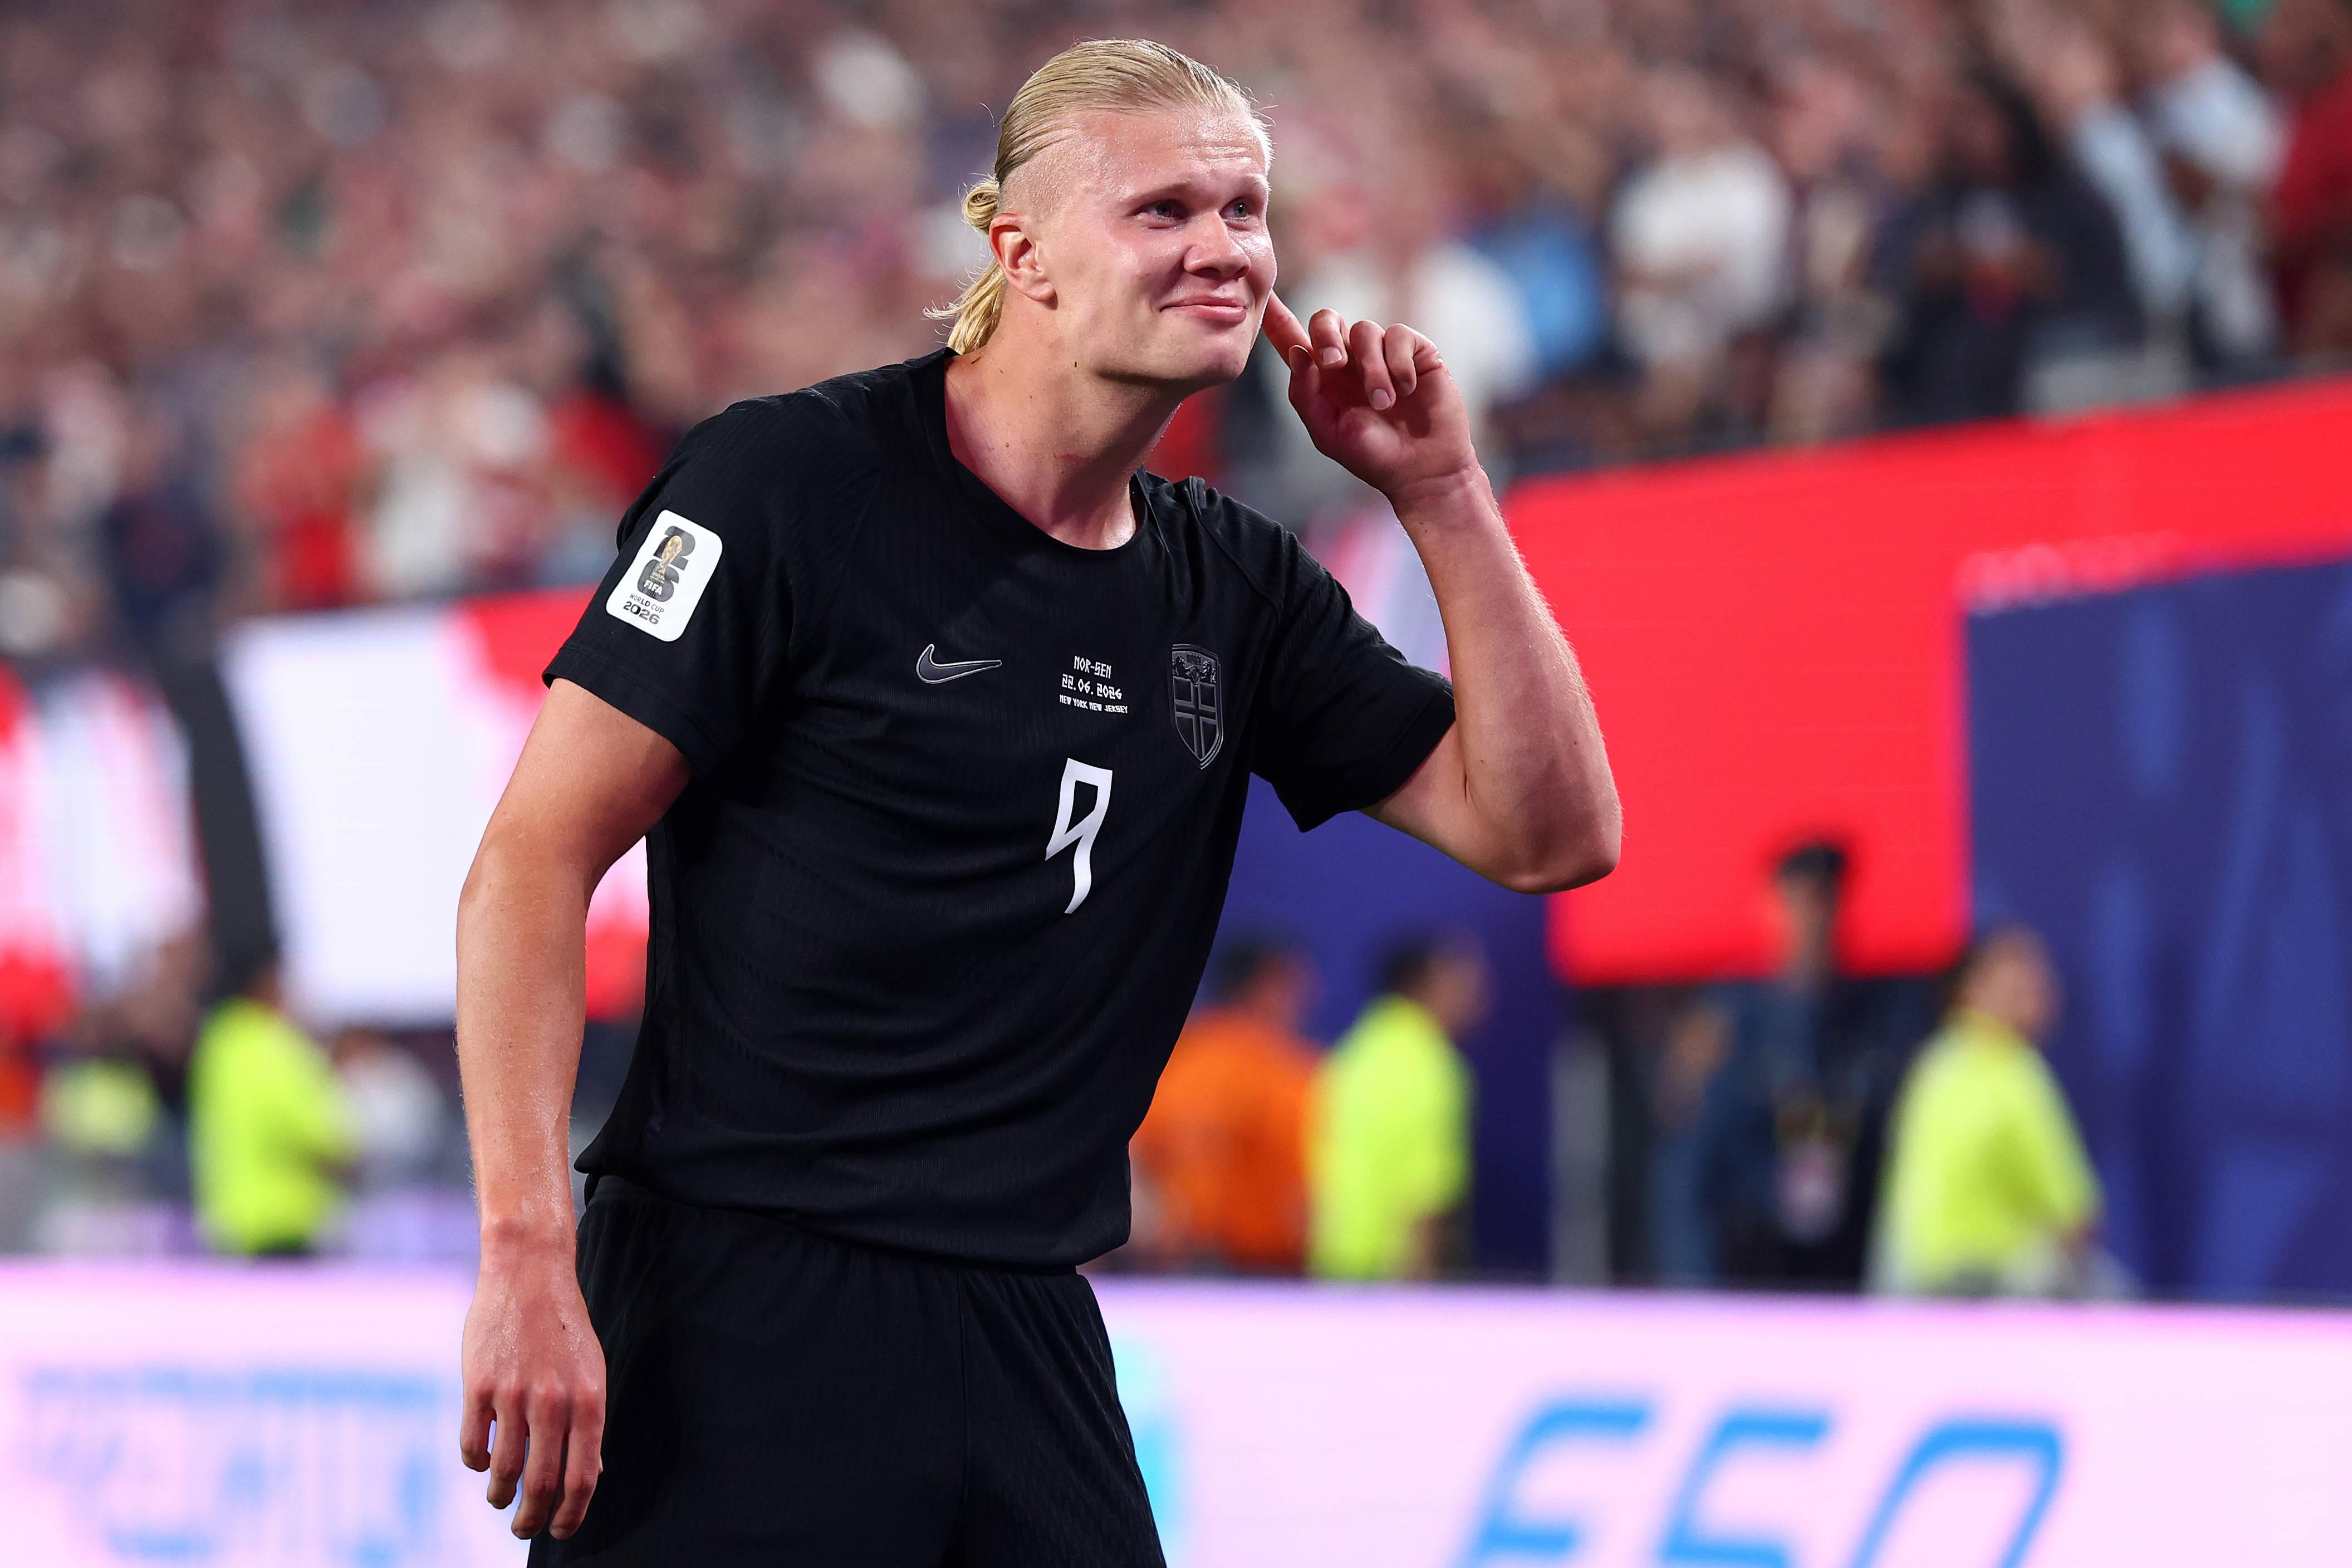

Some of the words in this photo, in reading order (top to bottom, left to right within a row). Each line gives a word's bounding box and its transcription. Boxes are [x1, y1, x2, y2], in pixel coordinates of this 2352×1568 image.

[643, 579, 663, 595] FIFA
[623, 601, 660, 625] 2026
[629, 593, 650, 607] WORLD
[650, 604, 664, 613] CUP
[1074, 655, 1111, 679] NOR-SEN
[1059, 694, 1072, 705] NEW
[1072, 697, 1088, 709] YORK
[1089, 702, 1102, 712] NEW
[1104, 705, 1128, 713] JERSEY
[1045, 757, 1113, 914] 9
